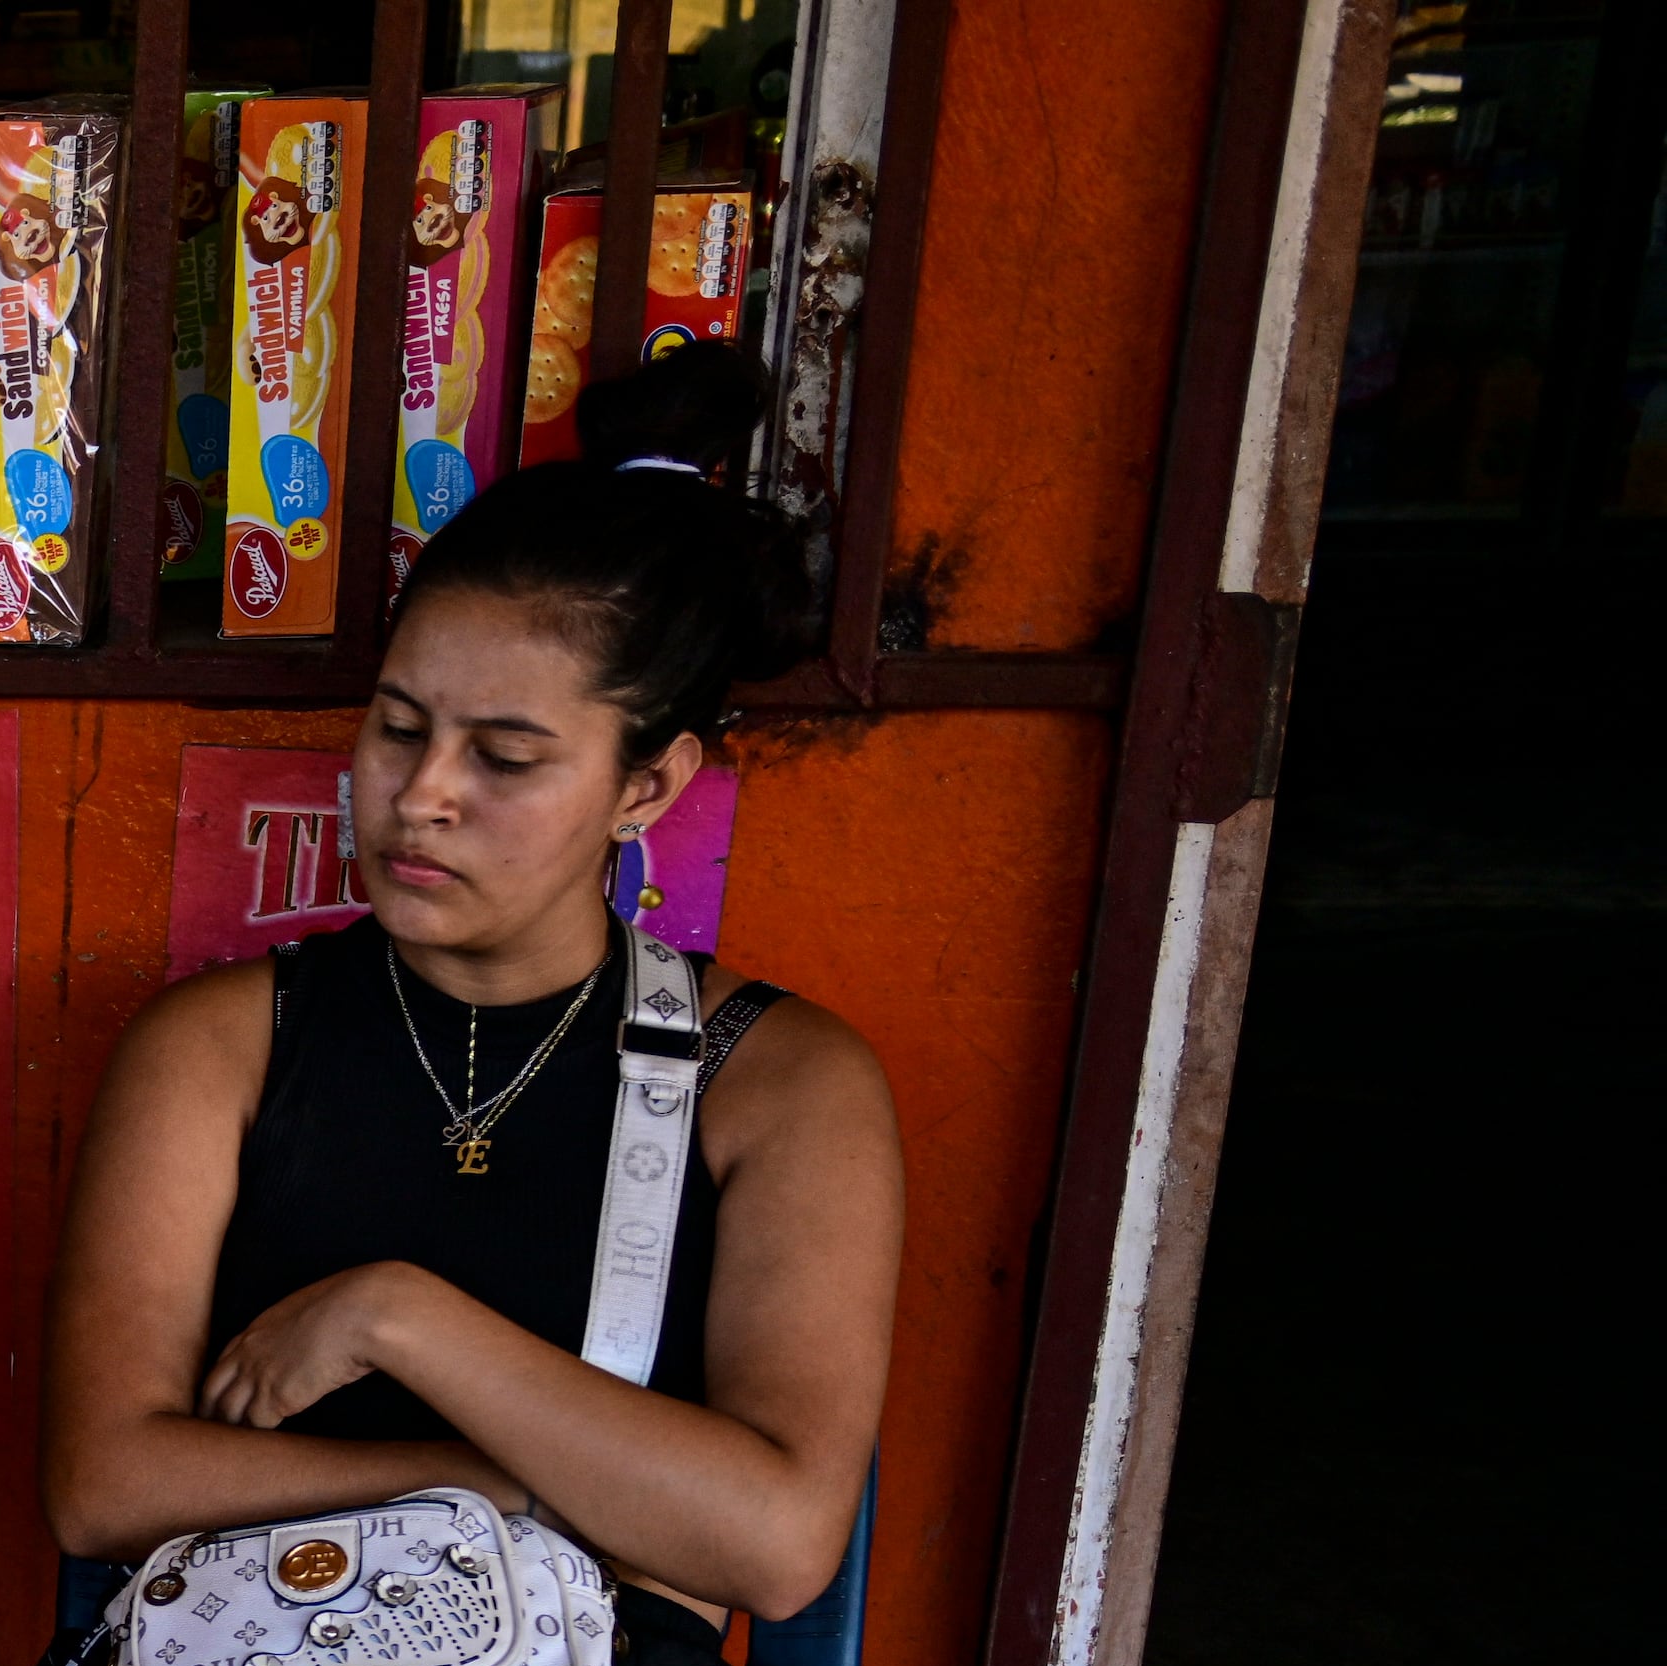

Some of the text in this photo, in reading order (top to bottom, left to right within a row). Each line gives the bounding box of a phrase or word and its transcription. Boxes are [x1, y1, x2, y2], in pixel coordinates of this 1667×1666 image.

[433, 278, 452, 337] FRESA
[247, 266, 288, 403] Sandwich
[198, 437, 218, 465] 36
[24, 494, 48, 523] 36
[281, 479, 305, 509] 36
[426, 487, 450, 518] 36
[301, 522, 313, 551] TRANS
[310, 527, 321, 542] FAT
[45, 538, 56, 565] TRANS
[53, 542, 65, 557] FAT
[239, 543, 278, 605] Pascual
